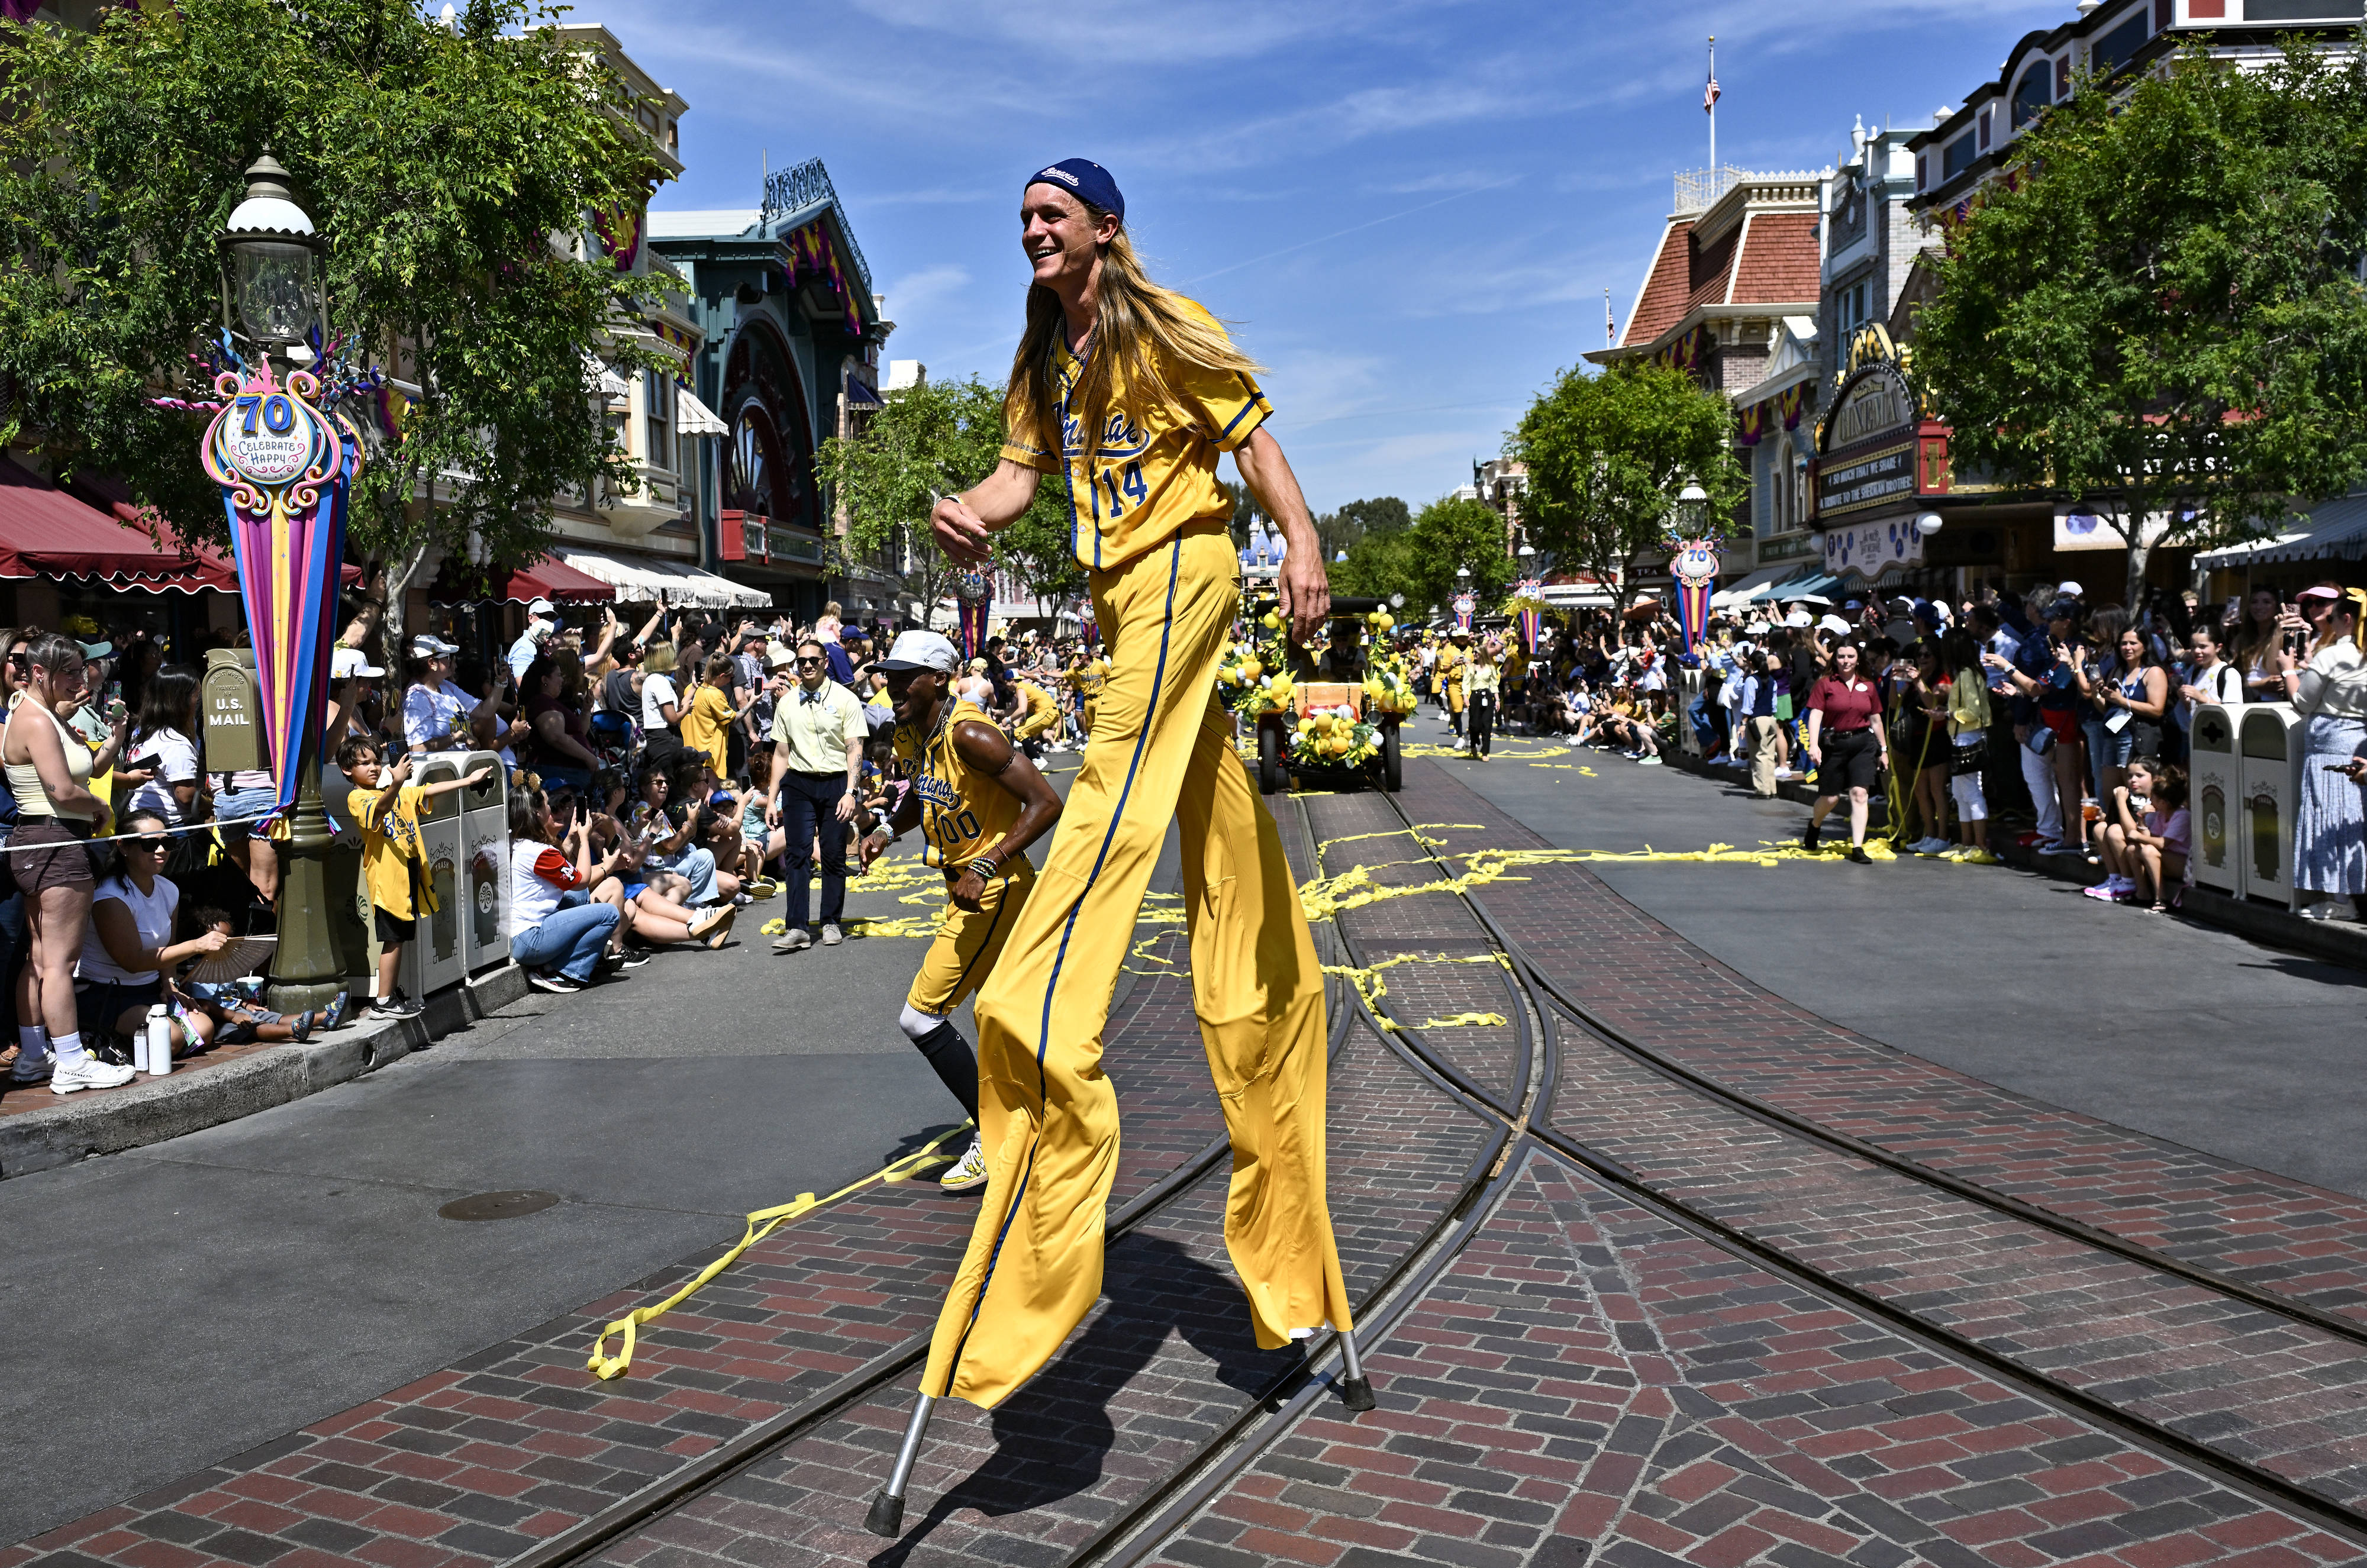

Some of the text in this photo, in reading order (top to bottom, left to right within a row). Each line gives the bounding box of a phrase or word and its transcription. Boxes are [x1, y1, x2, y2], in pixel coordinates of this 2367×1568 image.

[1041, 167, 1079, 186] Bananas
[234, 392, 296, 434] 70
[1838, 389, 1902, 443] CINEMA
[238, 441, 295, 456] CELEBRATE
[1840, 468, 1855, 482] MUCH
[1856, 464, 1869, 479] THAT
[1870, 462, 1878, 474] WE
[1879, 456, 1897, 472] SHARE
[1102, 460, 1149, 519] 14
[1843, 492, 1850, 504] TO
[898, 523, 907, 563] SHOP
[1688, 550, 1707, 562] 70
[964, 573, 981, 585] 70
[216, 698, 243, 710] U.S.
[209, 714, 250, 726] MAIL
[940, 810, 982, 844] 00
[435, 861, 449, 872] TRASH
[473, 853, 485, 866] RECYCLE
[59, 1070, 93, 1079] SALOMON
